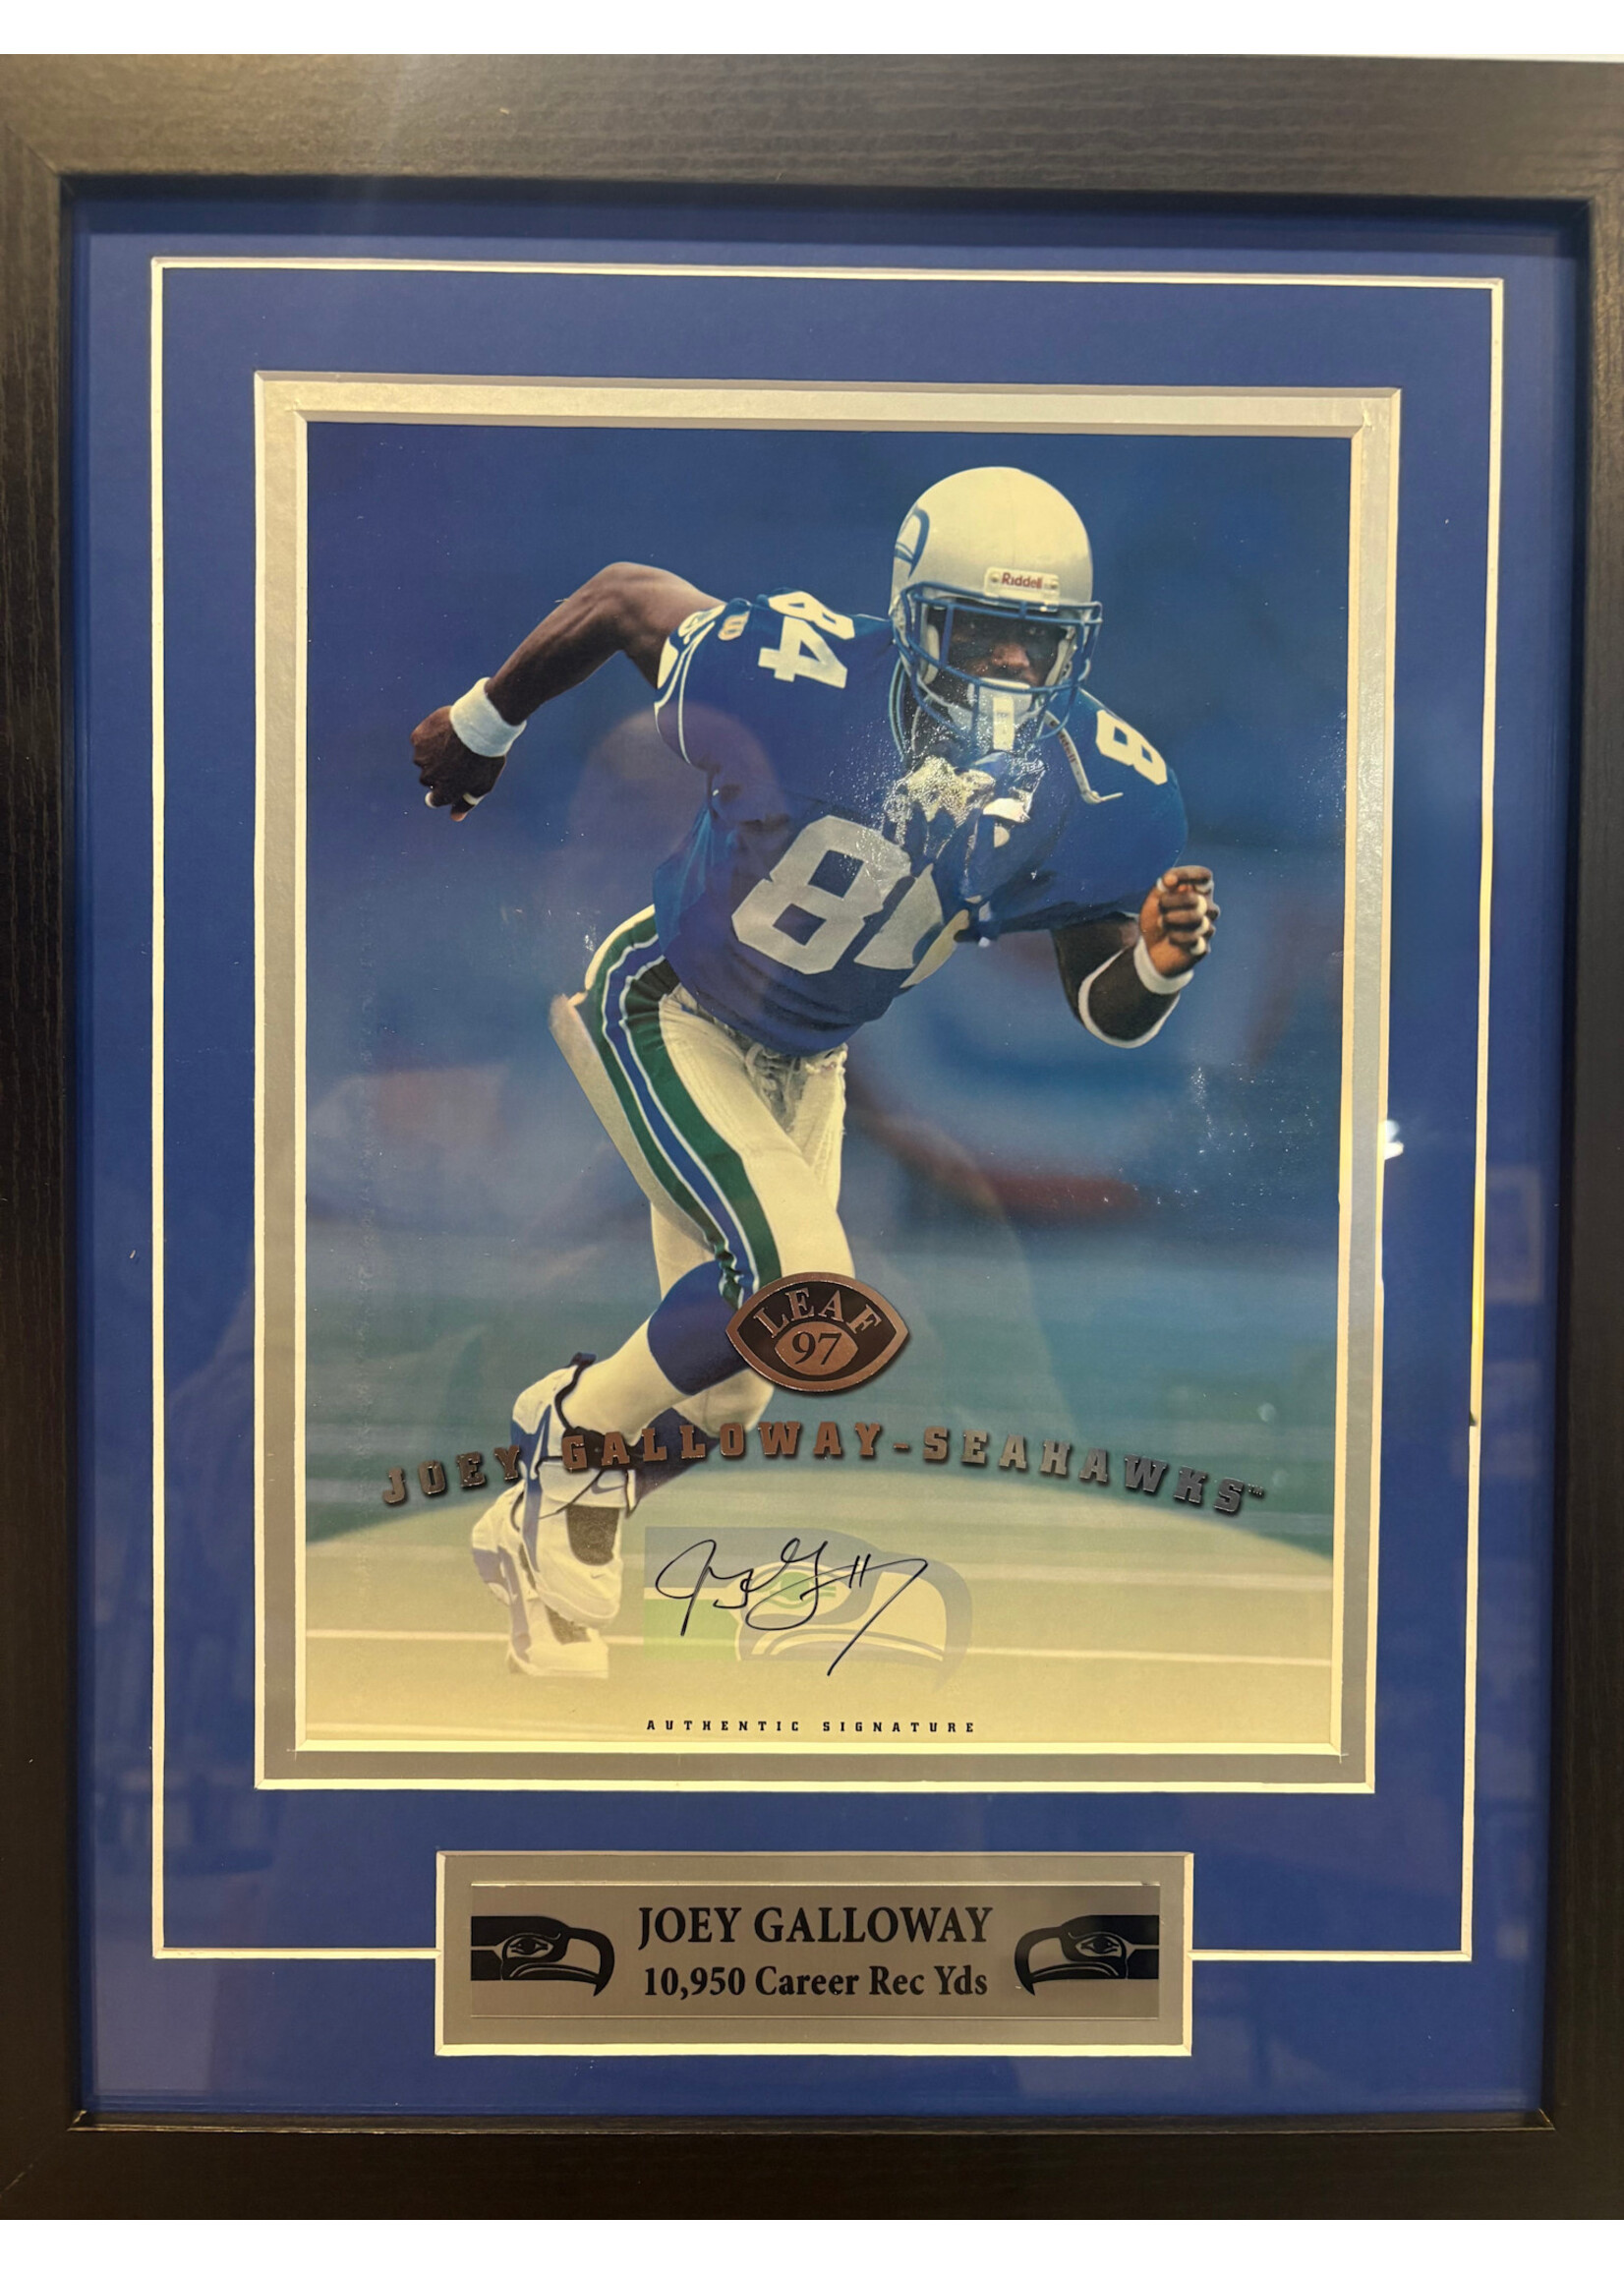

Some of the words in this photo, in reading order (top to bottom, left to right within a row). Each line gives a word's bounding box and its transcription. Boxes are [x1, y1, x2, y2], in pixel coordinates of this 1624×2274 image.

[1001, 572, 1043, 589] Riddell
[758, 591, 855, 688] 84
[752, 1287, 883, 1339] LEAF
[791, 1330, 842, 1366] 97
[382, 1444, 522, 1505] JOEY
[646, 1720, 799, 1732] AUTHENTIC
[822, 1720, 975, 1733] SIGNATURE
[638, 1906, 742, 1951] JOEY
[754, 1906, 994, 1943] GALLOWAY
[644, 1966, 746, 2001] 10,950
[755, 1965, 860, 1996] Career
[868, 1965, 925, 1996] Rec
[934, 1964, 988, 1996] Yds
